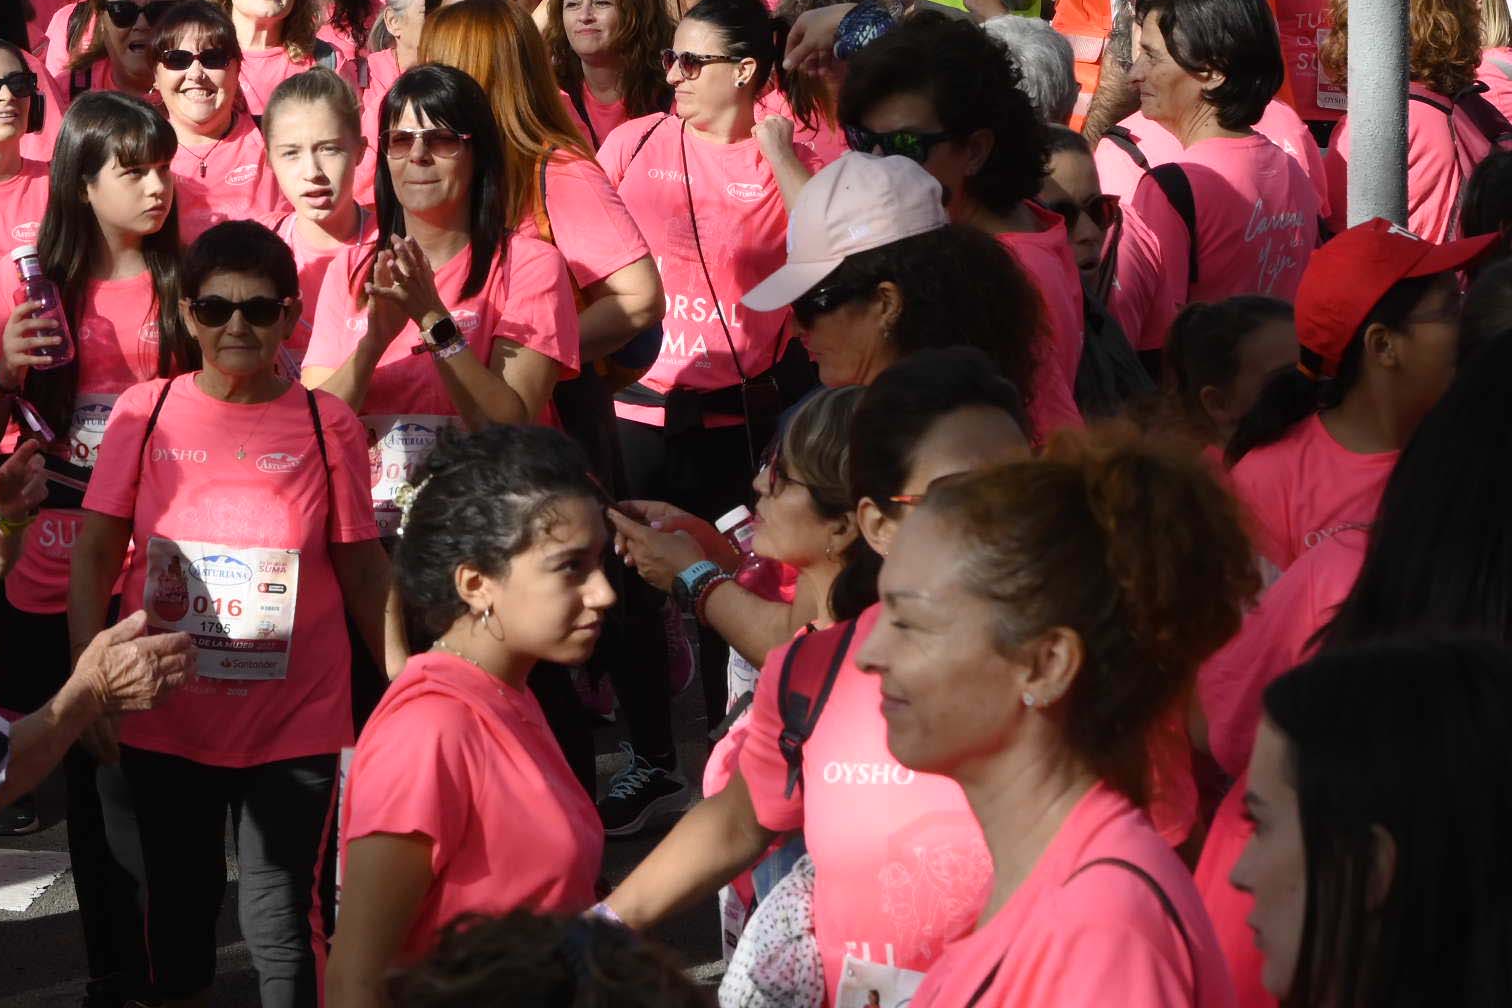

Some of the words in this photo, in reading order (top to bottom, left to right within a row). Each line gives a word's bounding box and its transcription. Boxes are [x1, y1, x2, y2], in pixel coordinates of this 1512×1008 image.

[661, 333, 710, 358] MA
[151, 448, 207, 464] OYSHO
[39, 519, 76, 548] SU
[191, 564, 250, 581] ASTURIANA
[258, 565, 287, 574] SUMA
[193, 596, 243, 618] 016
[200, 621, 232, 635] 1795
[199, 637, 211, 647] DE
[225, 639, 255, 649] MUJER
[823, 762, 915, 786] OYSHO
